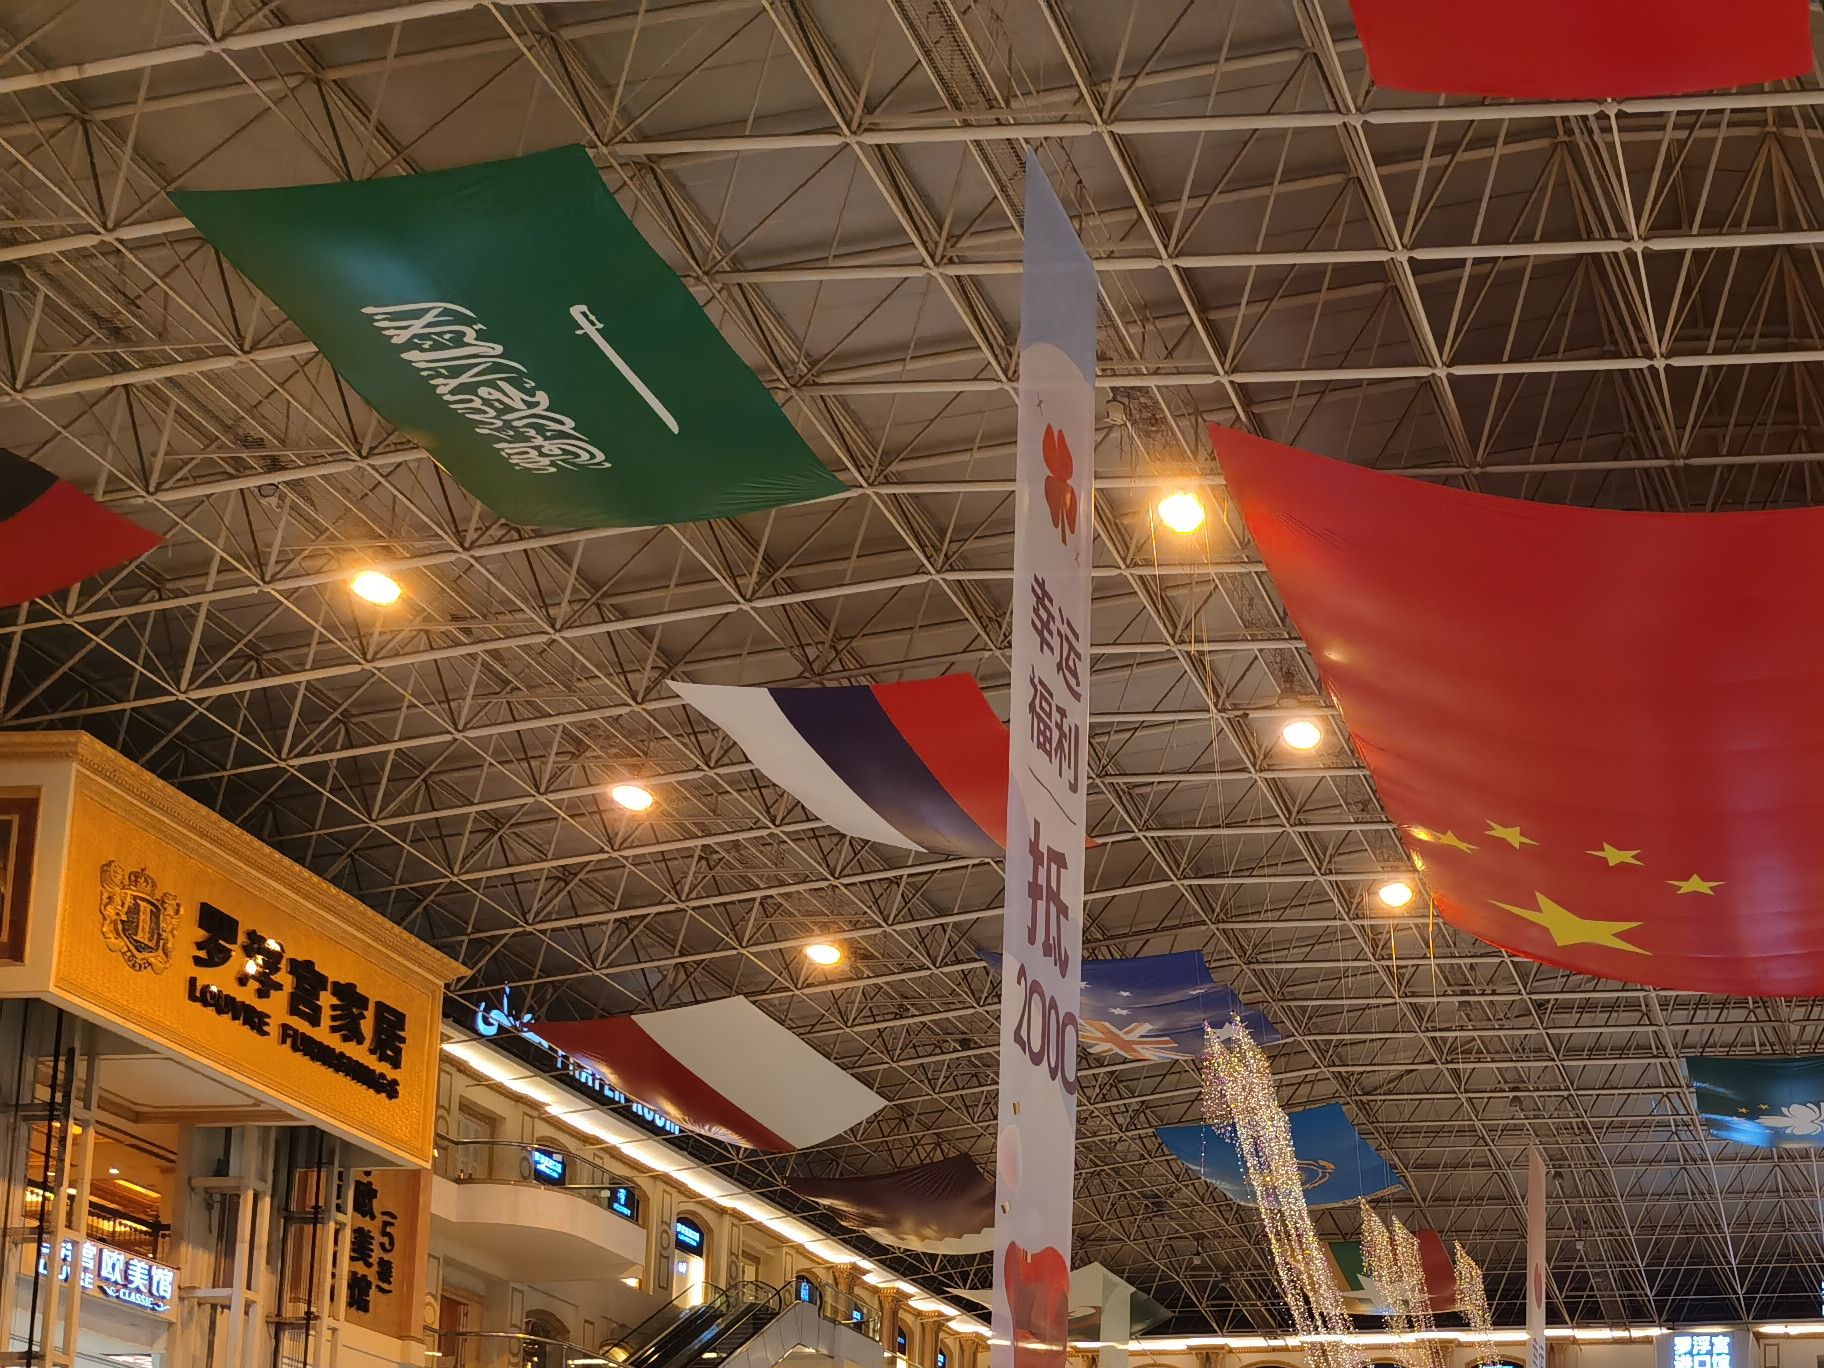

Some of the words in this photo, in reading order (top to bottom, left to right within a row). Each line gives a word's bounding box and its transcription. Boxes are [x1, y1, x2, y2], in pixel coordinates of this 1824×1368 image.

[1029, 573, 1082, 703] 幸运
[1027, 664, 1080, 794] 福利
[1027, 817, 1069, 979] 抵
[188, 976, 272, 1037] LOUVRE
[1013, 963, 1078, 1096] 2000
